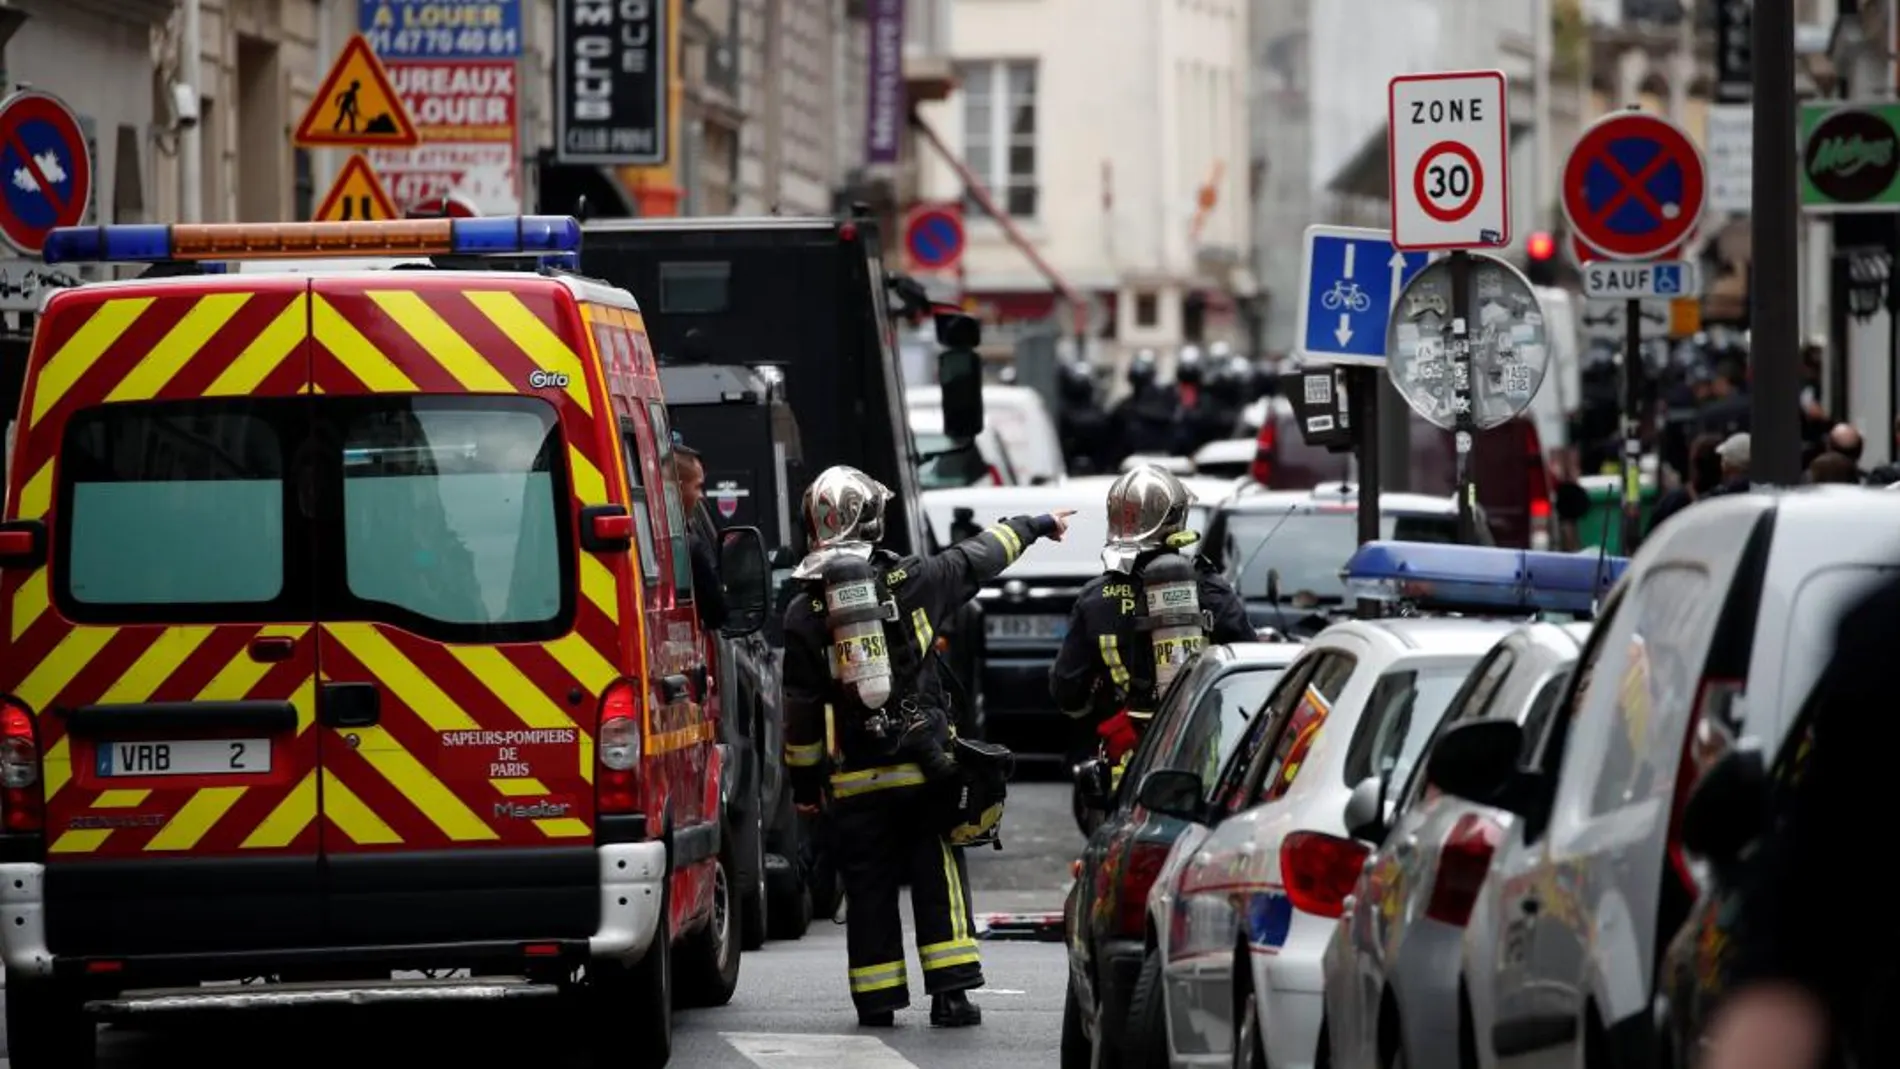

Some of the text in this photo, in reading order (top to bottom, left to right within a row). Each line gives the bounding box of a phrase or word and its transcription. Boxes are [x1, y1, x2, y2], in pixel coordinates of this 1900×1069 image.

[403, 5, 502, 28] LOUER
[394, 28, 422, 53] 47
[388, 67, 514, 95] UREAUX
[405, 97, 507, 124] LOUER
[1411, 98, 1484, 125] ZONE
[1428, 165, 1470, 198] 30
[1590, 270, 1650, 291] SAUF
[442, 729, 575, 746] SAPEURS-POMPIERS
[229, 742, 245, 769] 2
[498, 747, 517, 761] DE
[490, 762, 529, 777] PARIS
[493, 800, 571, 818] Master
